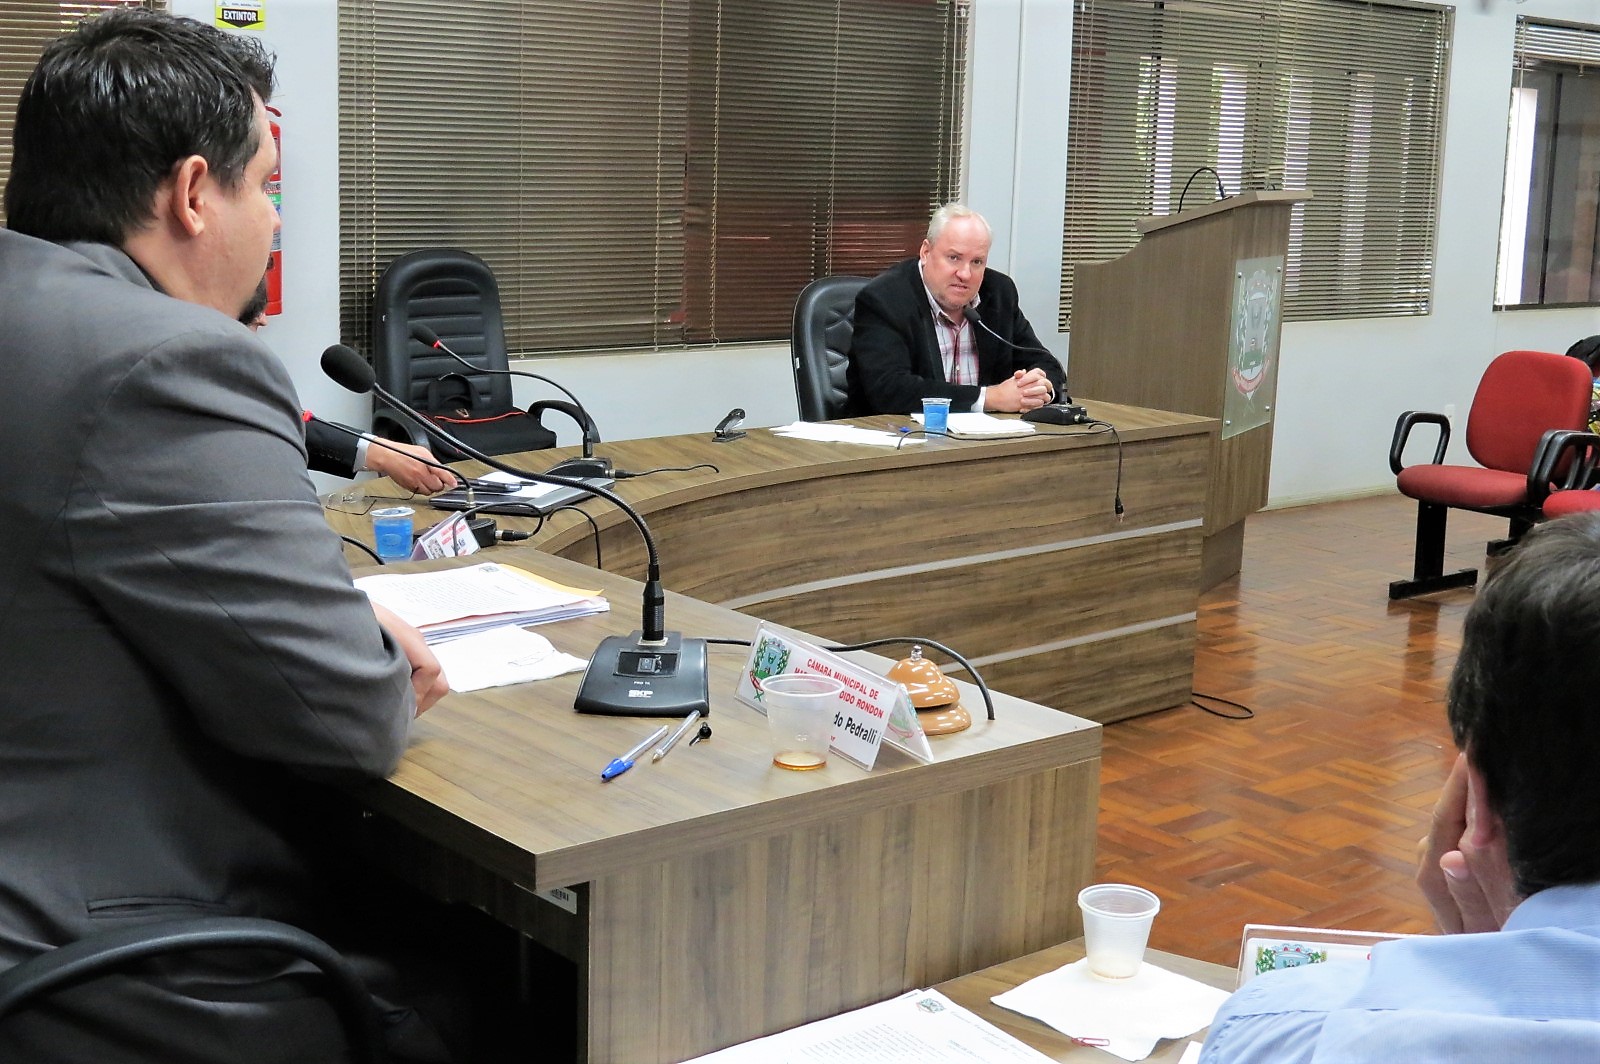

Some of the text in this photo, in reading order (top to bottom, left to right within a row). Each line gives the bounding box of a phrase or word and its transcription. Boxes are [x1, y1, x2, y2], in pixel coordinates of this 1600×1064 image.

[223, 10, 257, 21] EXTINTOR
[833, 671, 867, 695] MUNICIPAL
[869, 688, 880, 700] DE
[856, 698, 884, 719] RONDON
[844, 716, 878, 745] Pedralli
